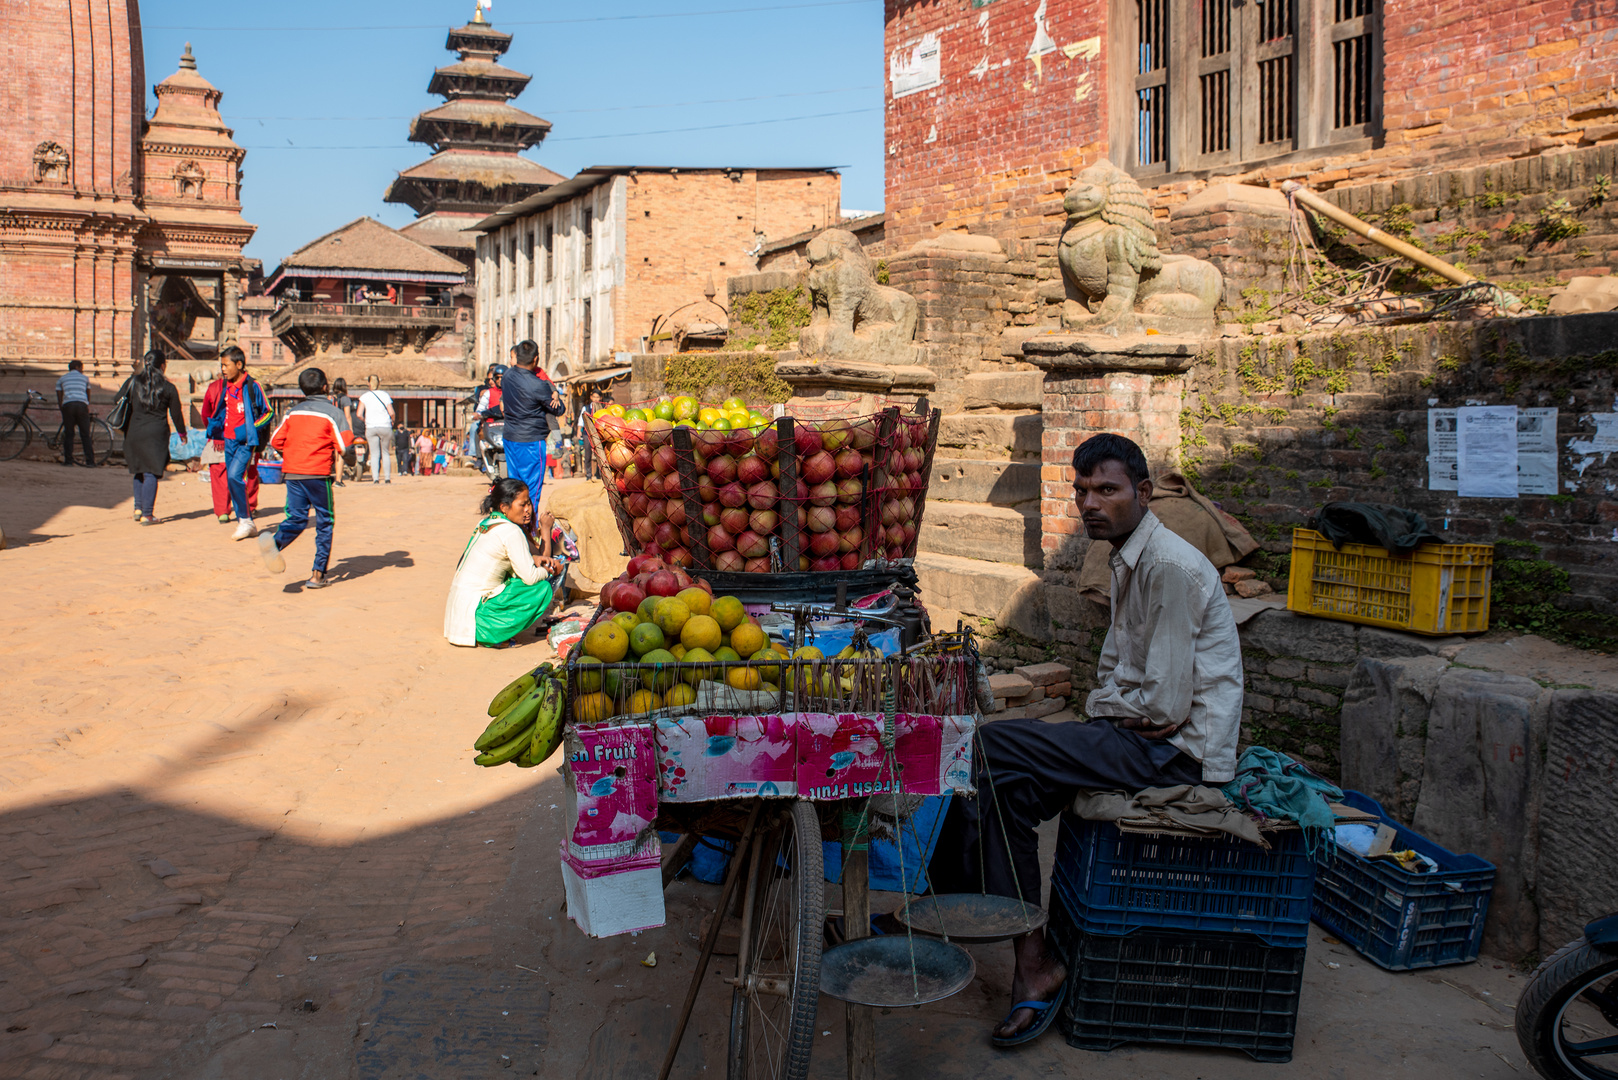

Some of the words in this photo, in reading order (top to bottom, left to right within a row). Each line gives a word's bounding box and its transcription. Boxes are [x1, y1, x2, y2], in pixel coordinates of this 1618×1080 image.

[594, 742, 637, 761] Fruit
[809, 783, 849, 799] Fruit
[853, 780, 901, 794] Fresh
